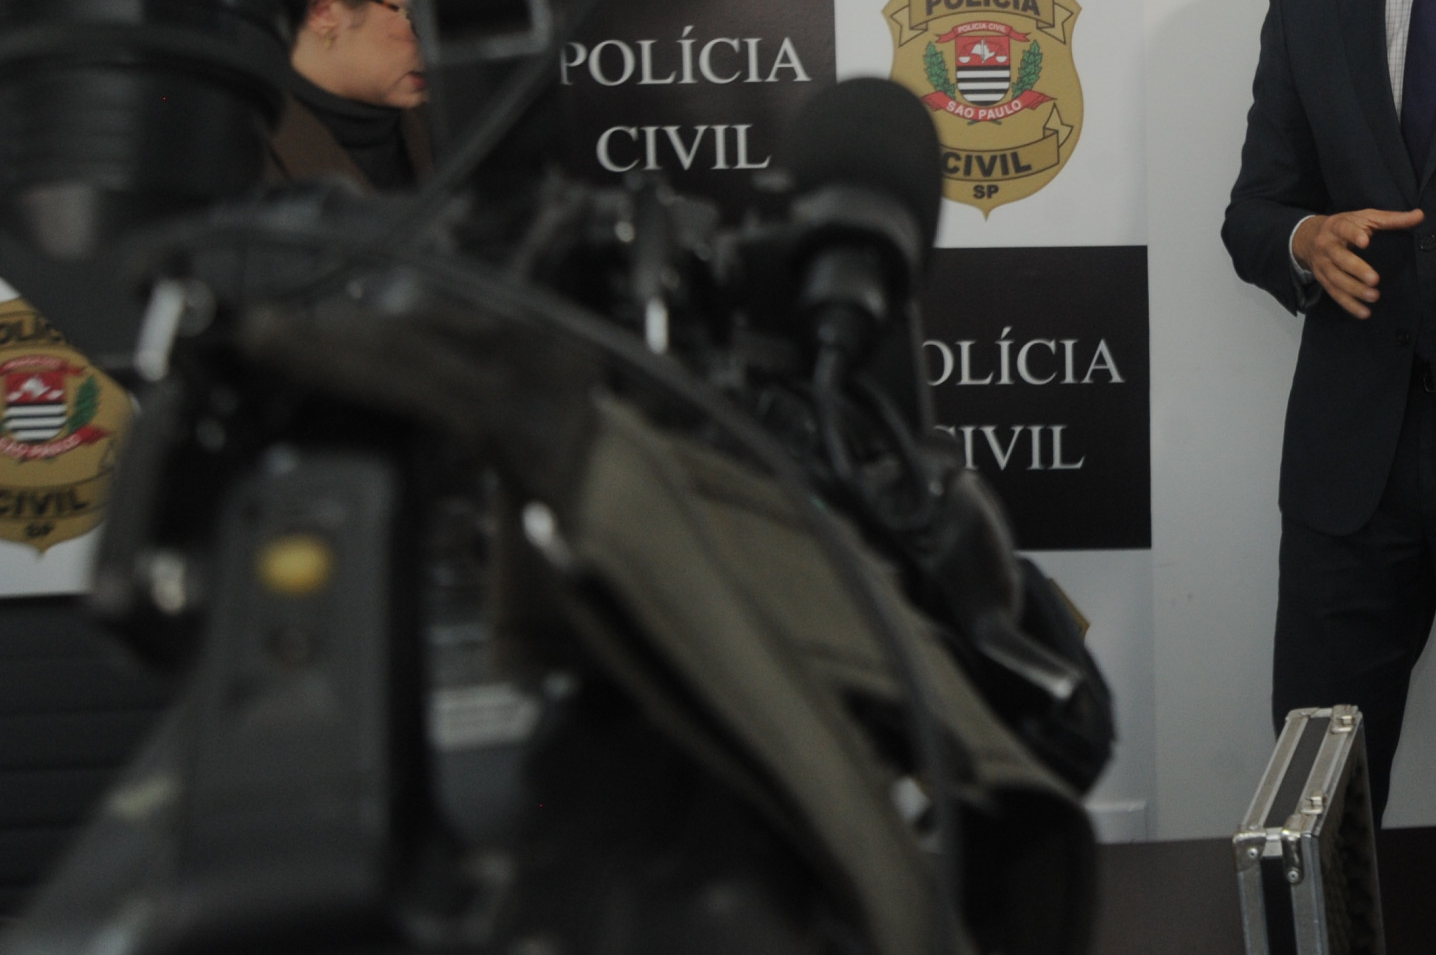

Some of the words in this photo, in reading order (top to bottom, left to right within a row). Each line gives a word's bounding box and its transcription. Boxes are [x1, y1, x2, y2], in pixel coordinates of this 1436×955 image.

[560, 25, 812, 87] POLÍCIA
[977, 100, 1023, 120] PAULO
[596, 124, 771, 173] CIVIL
[942, 151, 1033, 178] CIVIL
[973, 184, 999, 199] SP
[921, 326, 1126, 386] OLÍCIA
[934, 425, 1086, 471] IVIL
